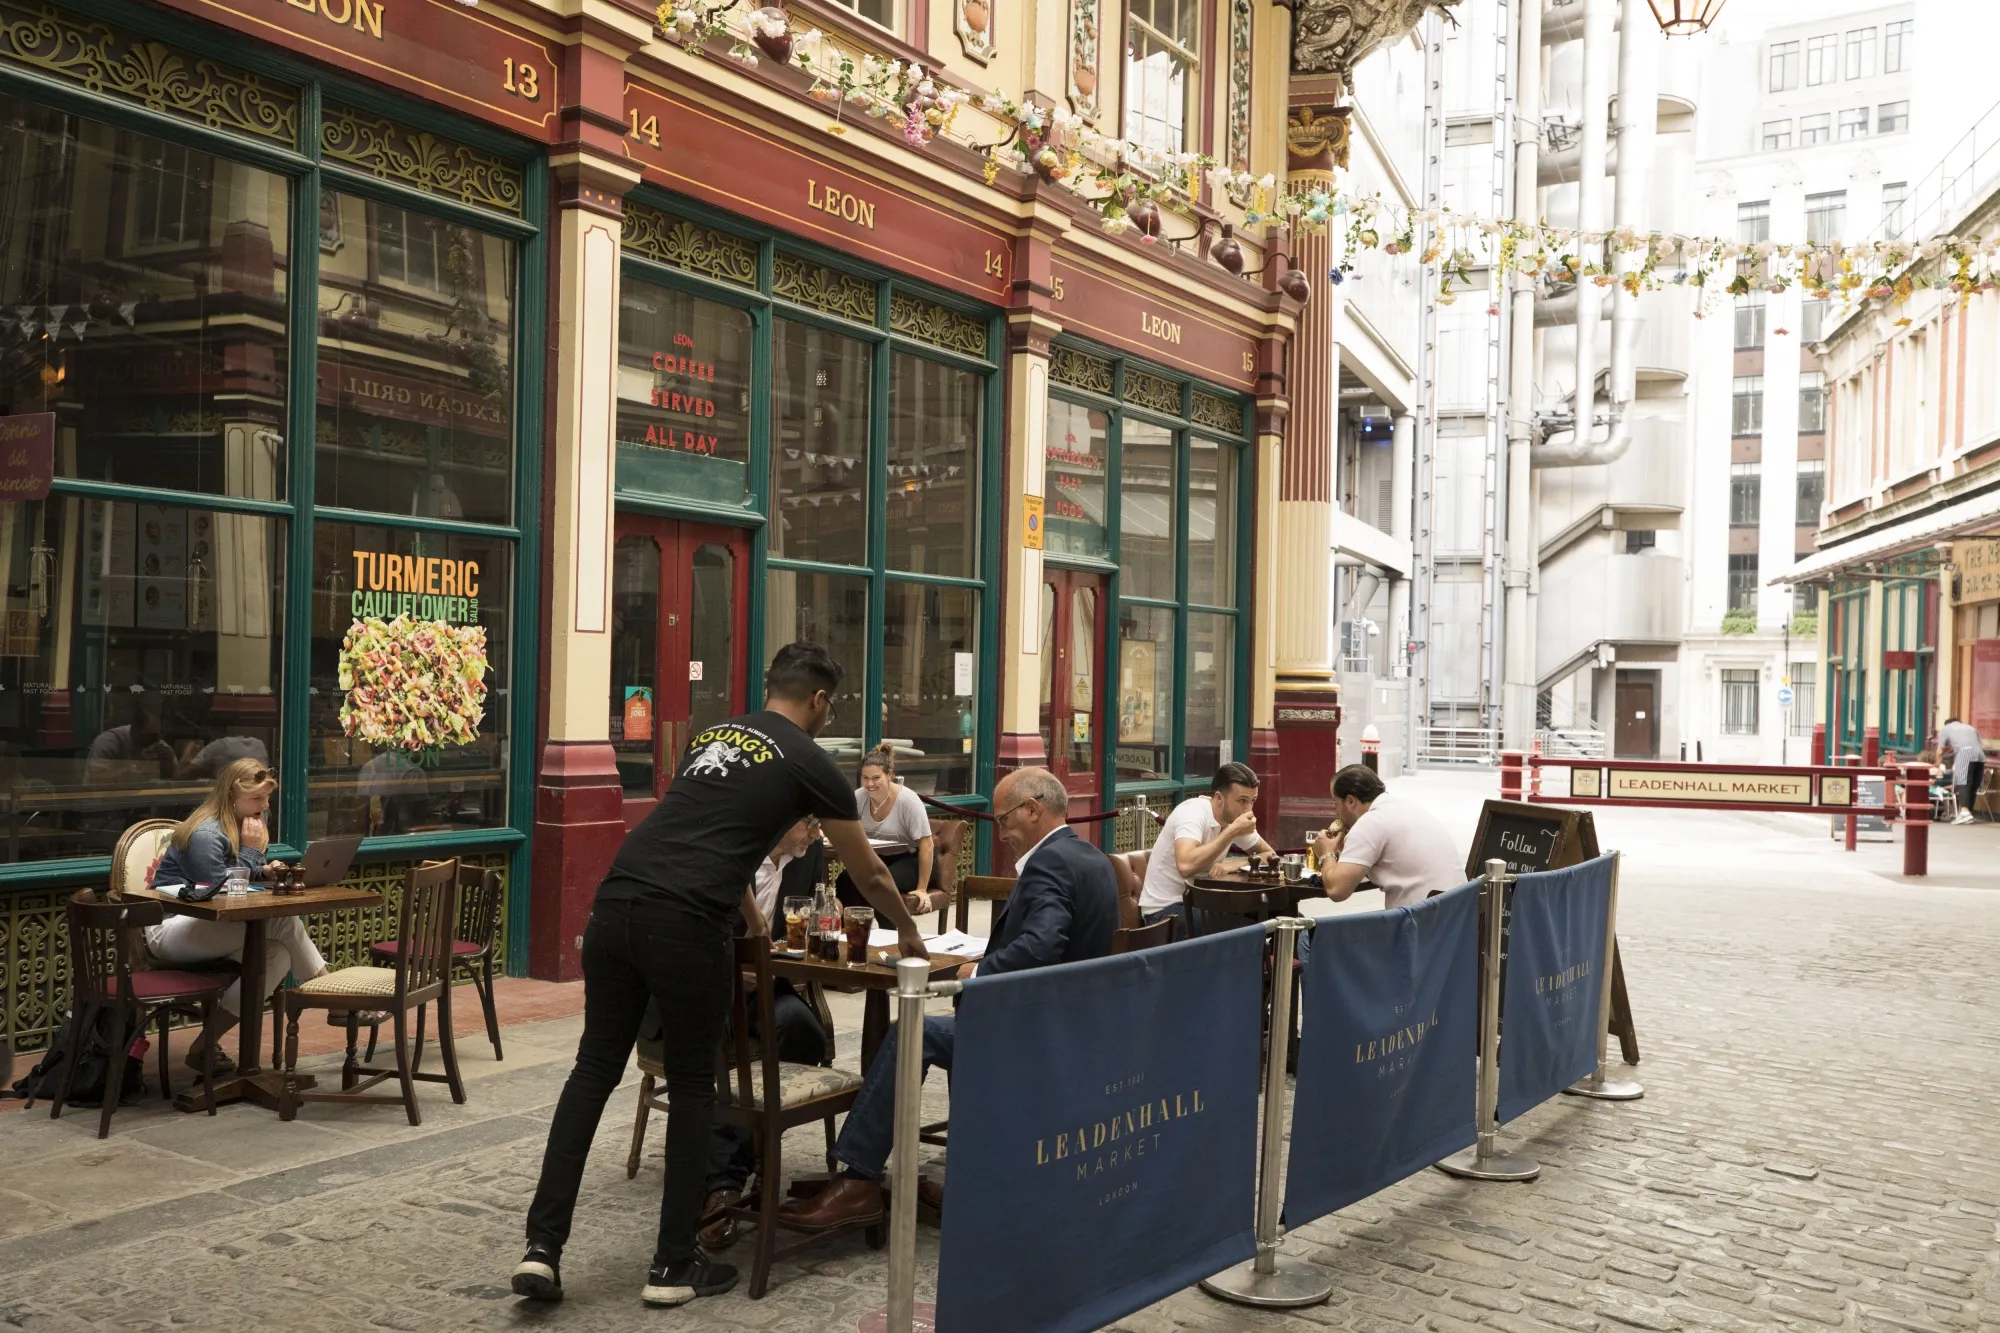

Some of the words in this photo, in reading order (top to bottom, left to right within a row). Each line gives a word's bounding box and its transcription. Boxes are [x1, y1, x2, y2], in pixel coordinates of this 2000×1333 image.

[503, 57, 539, 99] 13
[629, 107, 661, 146] 14
[807, 179, 876, 229] LEON
[984, 249, 1003, 279] 14
[1141, 311, 1181, 344] LEON
[652, 351, 715, 382] COFFEE
[1242, 351, 1254, 372] 15
[651, 387, 715, 418] SERVED
[645, 423, 676, 447] ALL
[684, 430, 718, 454] DAY
[8, 447, 29, 467] del
[1059, 474, 1082, 491] FAST
[1056, 501, 1084, 518] FOOD
[353, 551, 479, 598] TURMERIC
[351, 590, 468, 623] CAULIFLOWER
[470, 598, 479, 623] SALAD
[630, 709, 646, 718] JOBS
[691, 729, 773, 763] YOUNG'S
[746, 727, 769, 740] ALWAYS
[385, 745, 440, 768] LEON
[1619, 779, 1728, 792] LEADENHALL
[1732, 783, 1801, 795] MARKET
[1500, 831, 1537, 855] Follow
[1105, 1081, 1124, 1095] EST
[1035, 1089, 1205, 1165] LEADENHALL
[1076, 1133, 1162, 1181] MARKET
[1099, 1181, 1138, 1206] LONDON
